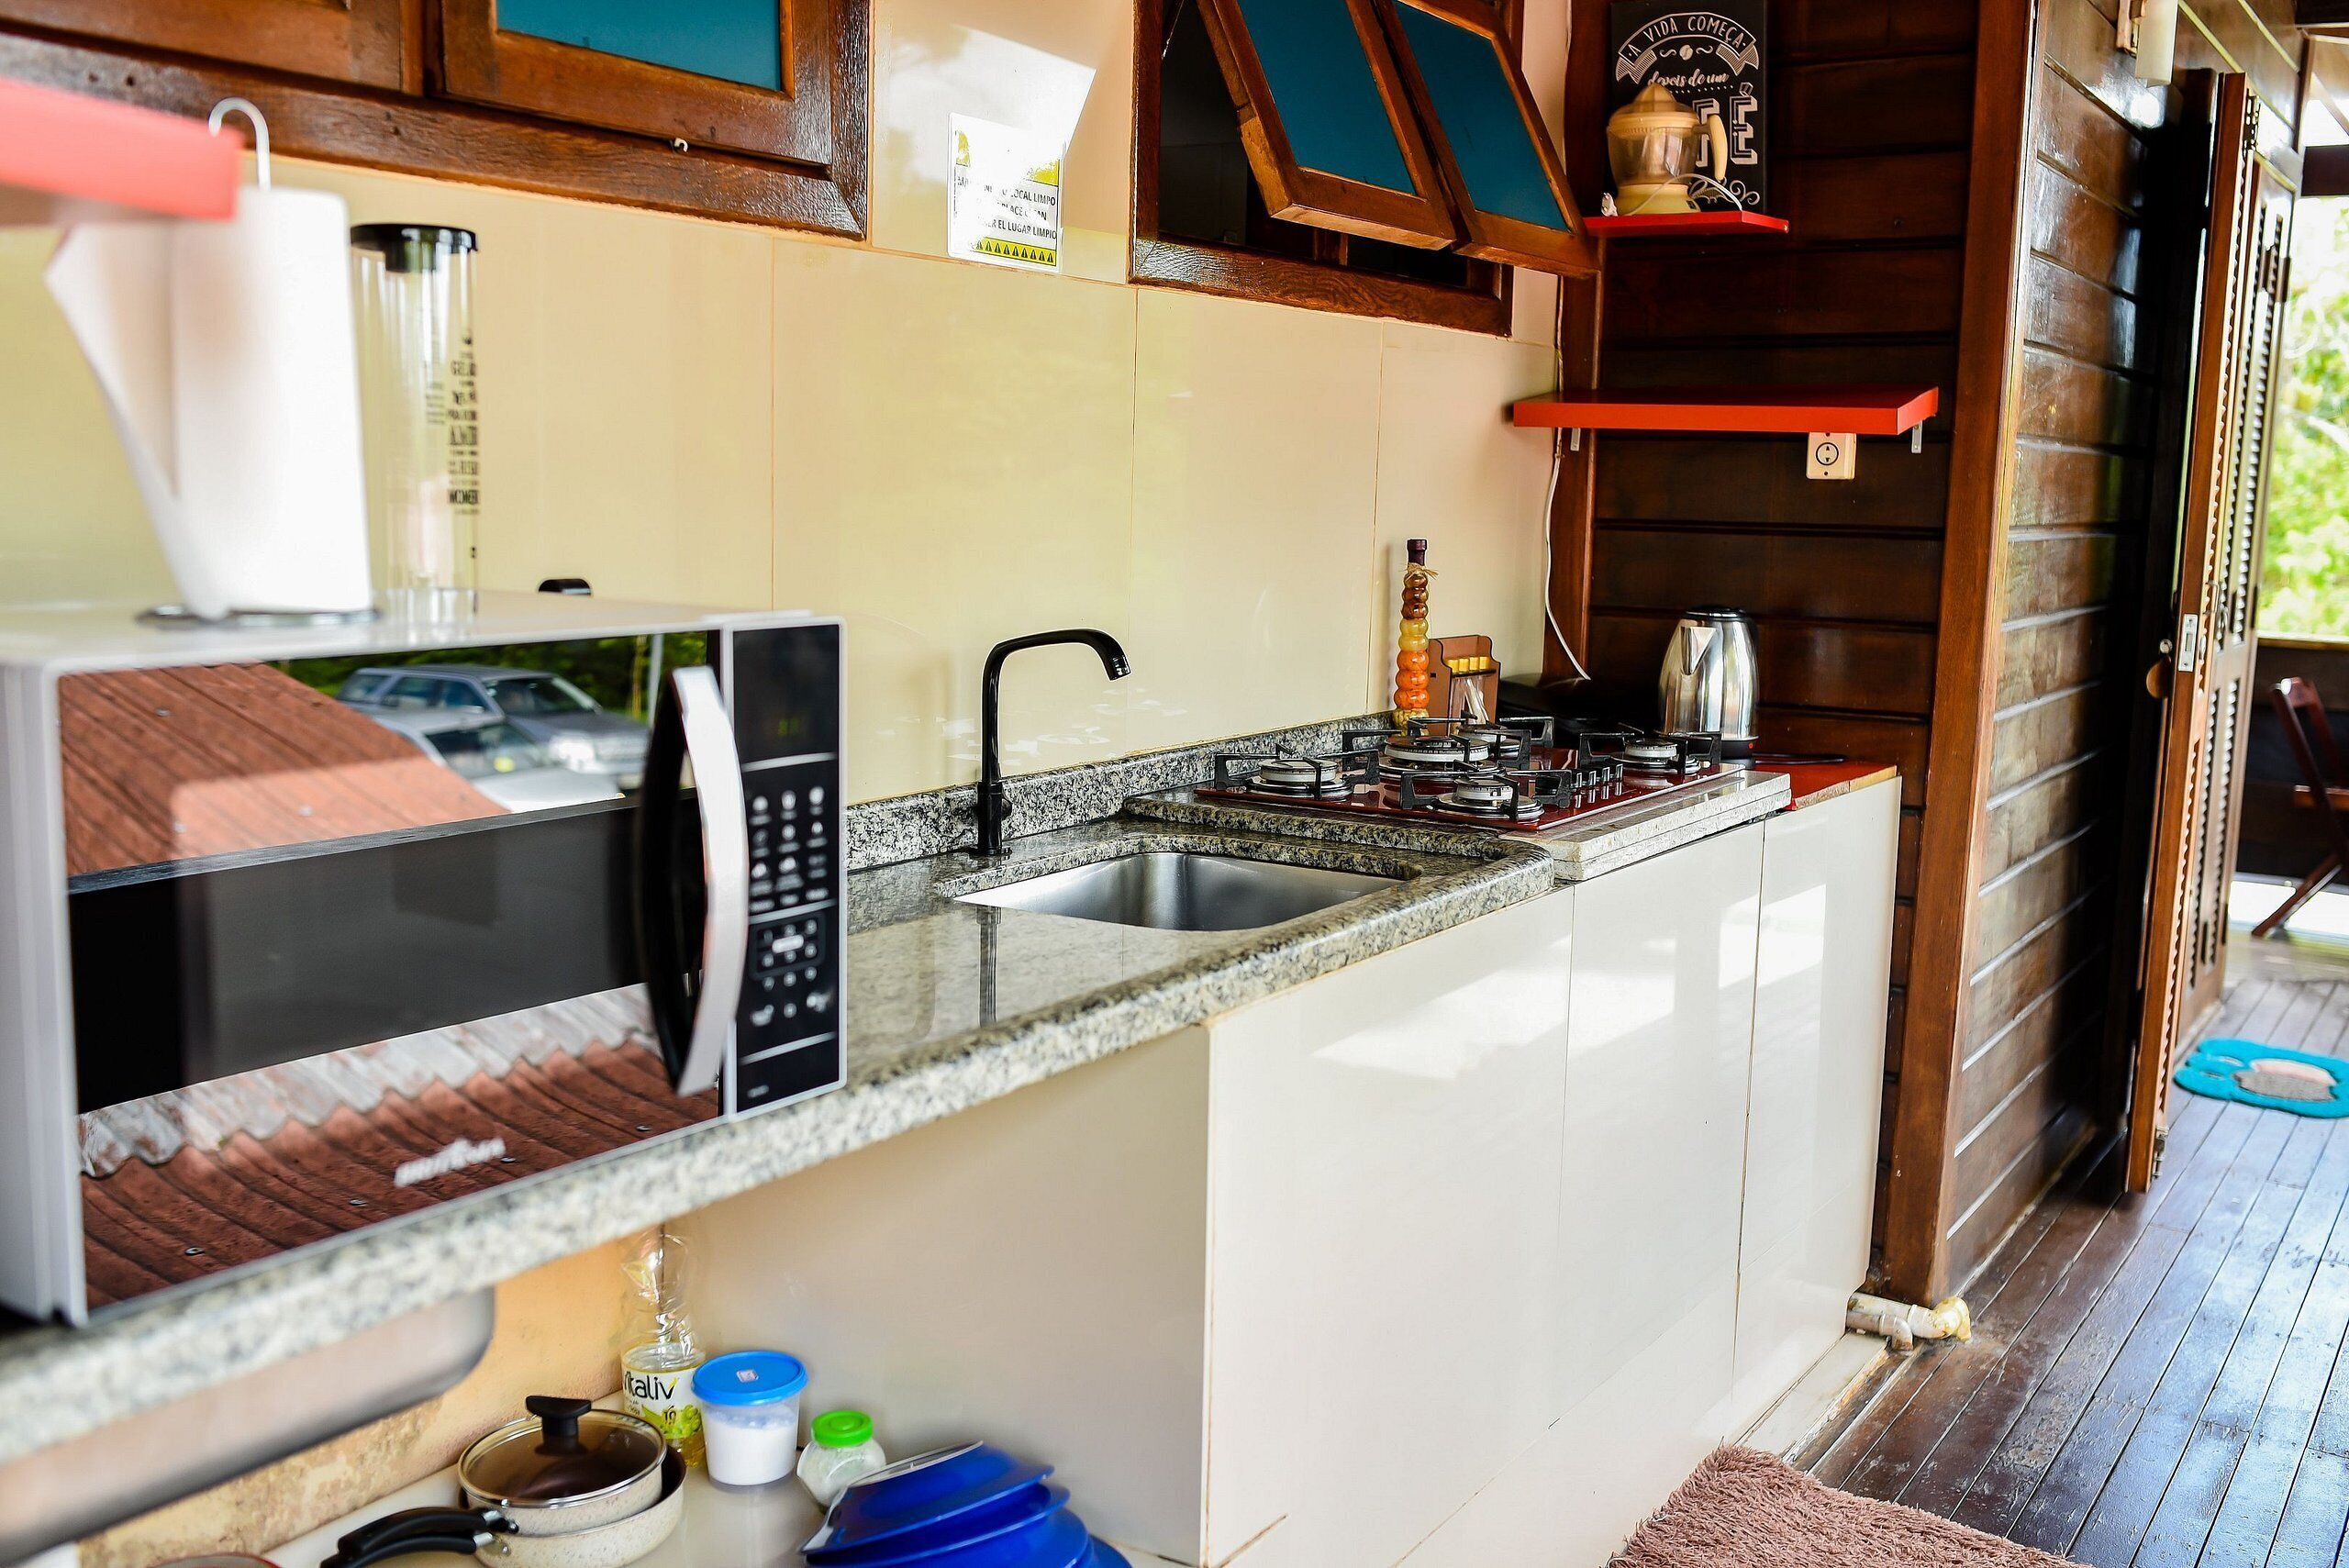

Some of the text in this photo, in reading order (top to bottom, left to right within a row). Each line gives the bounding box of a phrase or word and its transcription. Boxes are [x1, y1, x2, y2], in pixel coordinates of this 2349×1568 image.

[1643, 17, 1678, 42] VIDA
[1687, 17, 1744, 48] COMEÇA
[1688, 69, 1706, 86] de
[1707, 73, 1729, 83] um
[1034, 193, 1056, 206] LIMPO
[998, 219, 1006, 230] EL
[1008, 221, 1031, 235] LUGAR
[1033, 226, 1057, 239] LIMPIO
